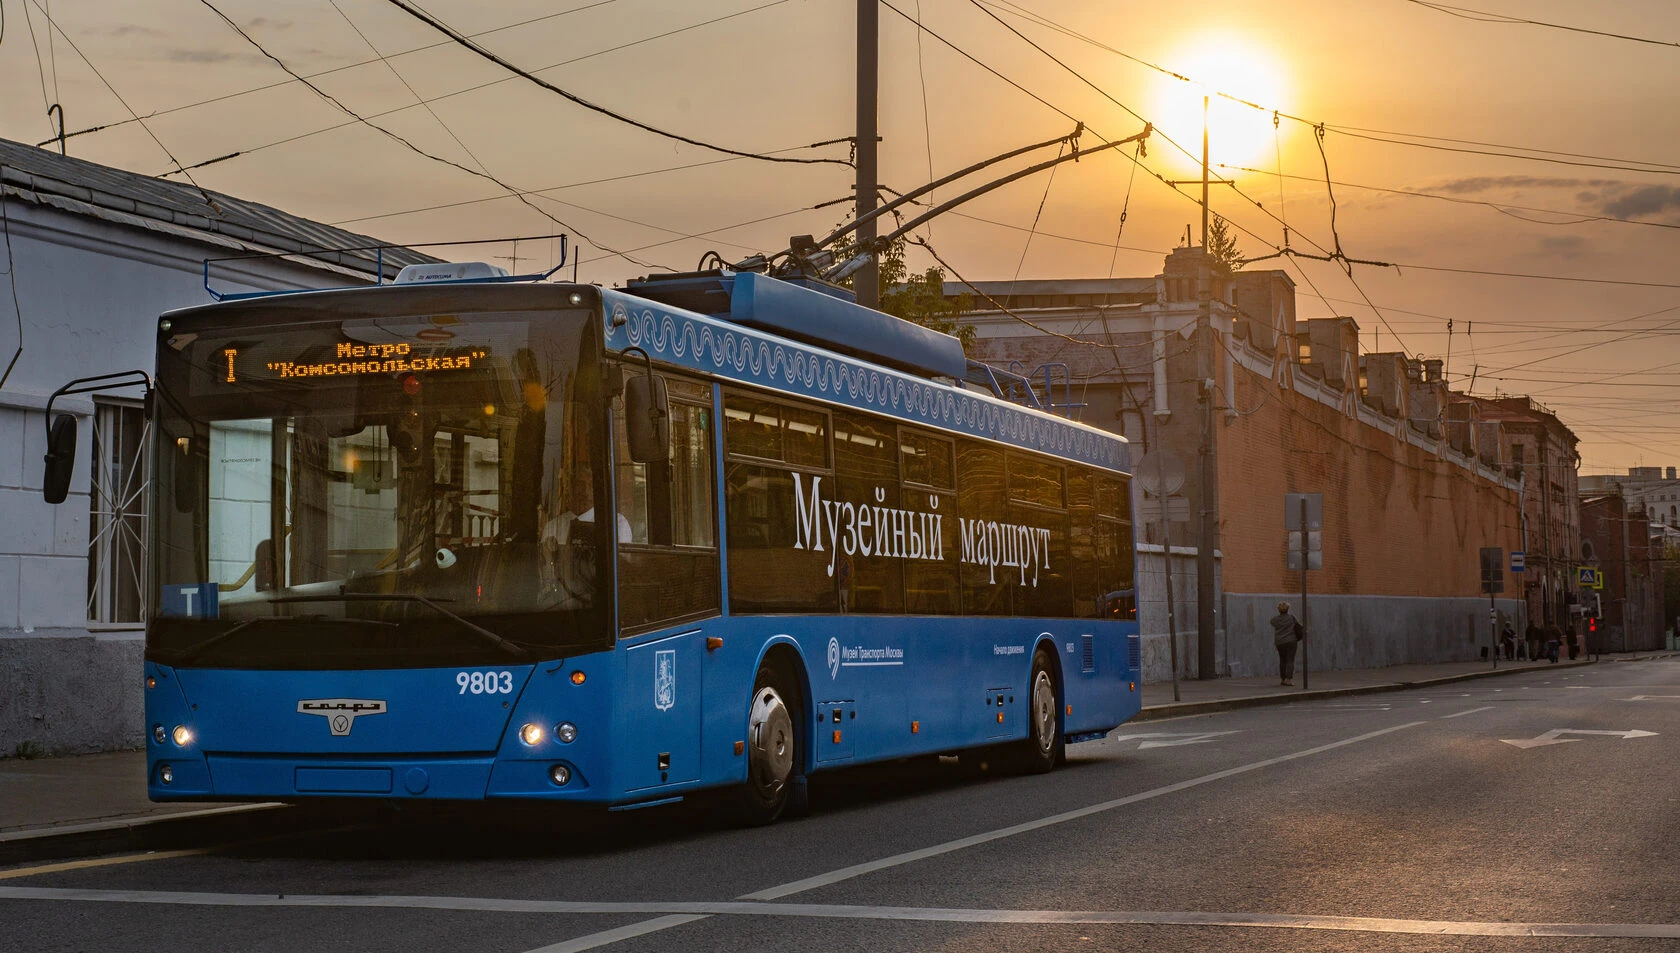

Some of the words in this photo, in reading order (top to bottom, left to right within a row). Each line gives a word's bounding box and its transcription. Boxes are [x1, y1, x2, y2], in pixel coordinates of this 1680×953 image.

[337, 342, 410, 359] Метро
[791, 472, 945, 577] Музейный
[959, 517, 1051, 588] маршрут
[842, 646, 858, 661] Музей
[858, 646, 884, 661] Транспорта
[885, 646, 903, 658] Москвы
[456, 671, 513, 694] 9803
